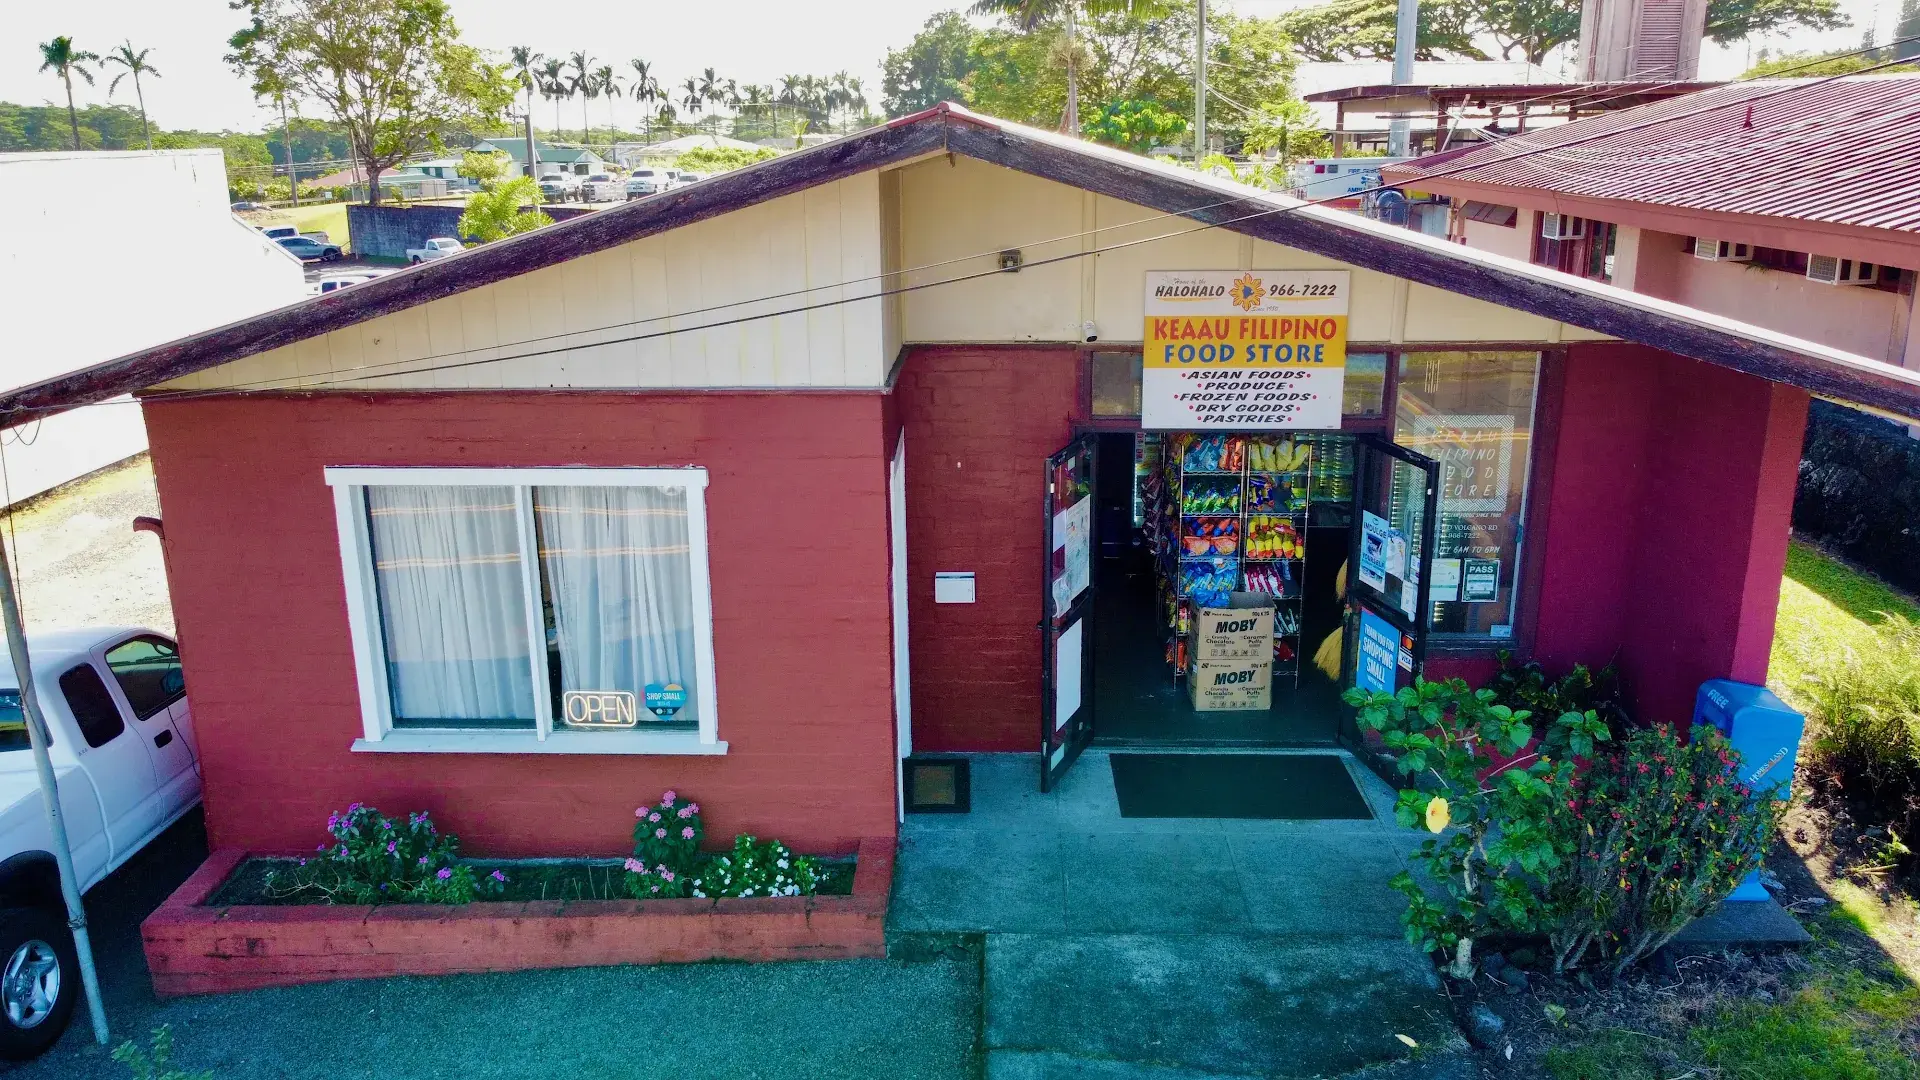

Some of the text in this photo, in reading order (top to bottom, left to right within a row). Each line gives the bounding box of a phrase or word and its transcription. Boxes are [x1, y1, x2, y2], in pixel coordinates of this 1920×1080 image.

[1155, 285, 1225, 297] HALOHALO
[1269, 284, 1337, 296] 966-7222
[1154, 318, 1337, 340] KEAAU FILIPINO
[1164, 344, 1325, 363] FOOD STORE
[1187, 371, 1306, 379] ASIAN FOODS
[1204, 382, 1287, 390] PRODUCE
[1180, 393, 1311, 401] FROZEN FOODS
[1195, 404, 1294, 412] DRY GOODS
[1202, 415, 1286, 423] PASTRIES
[1430, 430, 1497, 442] KEAAU
[1430, 448, 1496, 461] FILIPINO
[1446, 466, 1494, 479] OOD
[1453, 546, 1470, 554] 6AM
[1472, 546, 1482, 554] TO
[1485, 546, 1500, 554] 6PM
[1469, 565, 1494, 573] PASS
[1215, 618, 1258, 633] MOBY
[1363, 636, 1394, 671] SHOPPING
[1401, 656, 1411, 665] VISA
[1366, 657, 1386, 684] SMALL
[1213, 670, 1256, 685] MOBY
[646, 692, 681, 701] SHOP SMALL
[1707, 688, 1730, 710] FREE
[567, 694, 633, 723] OPEN
